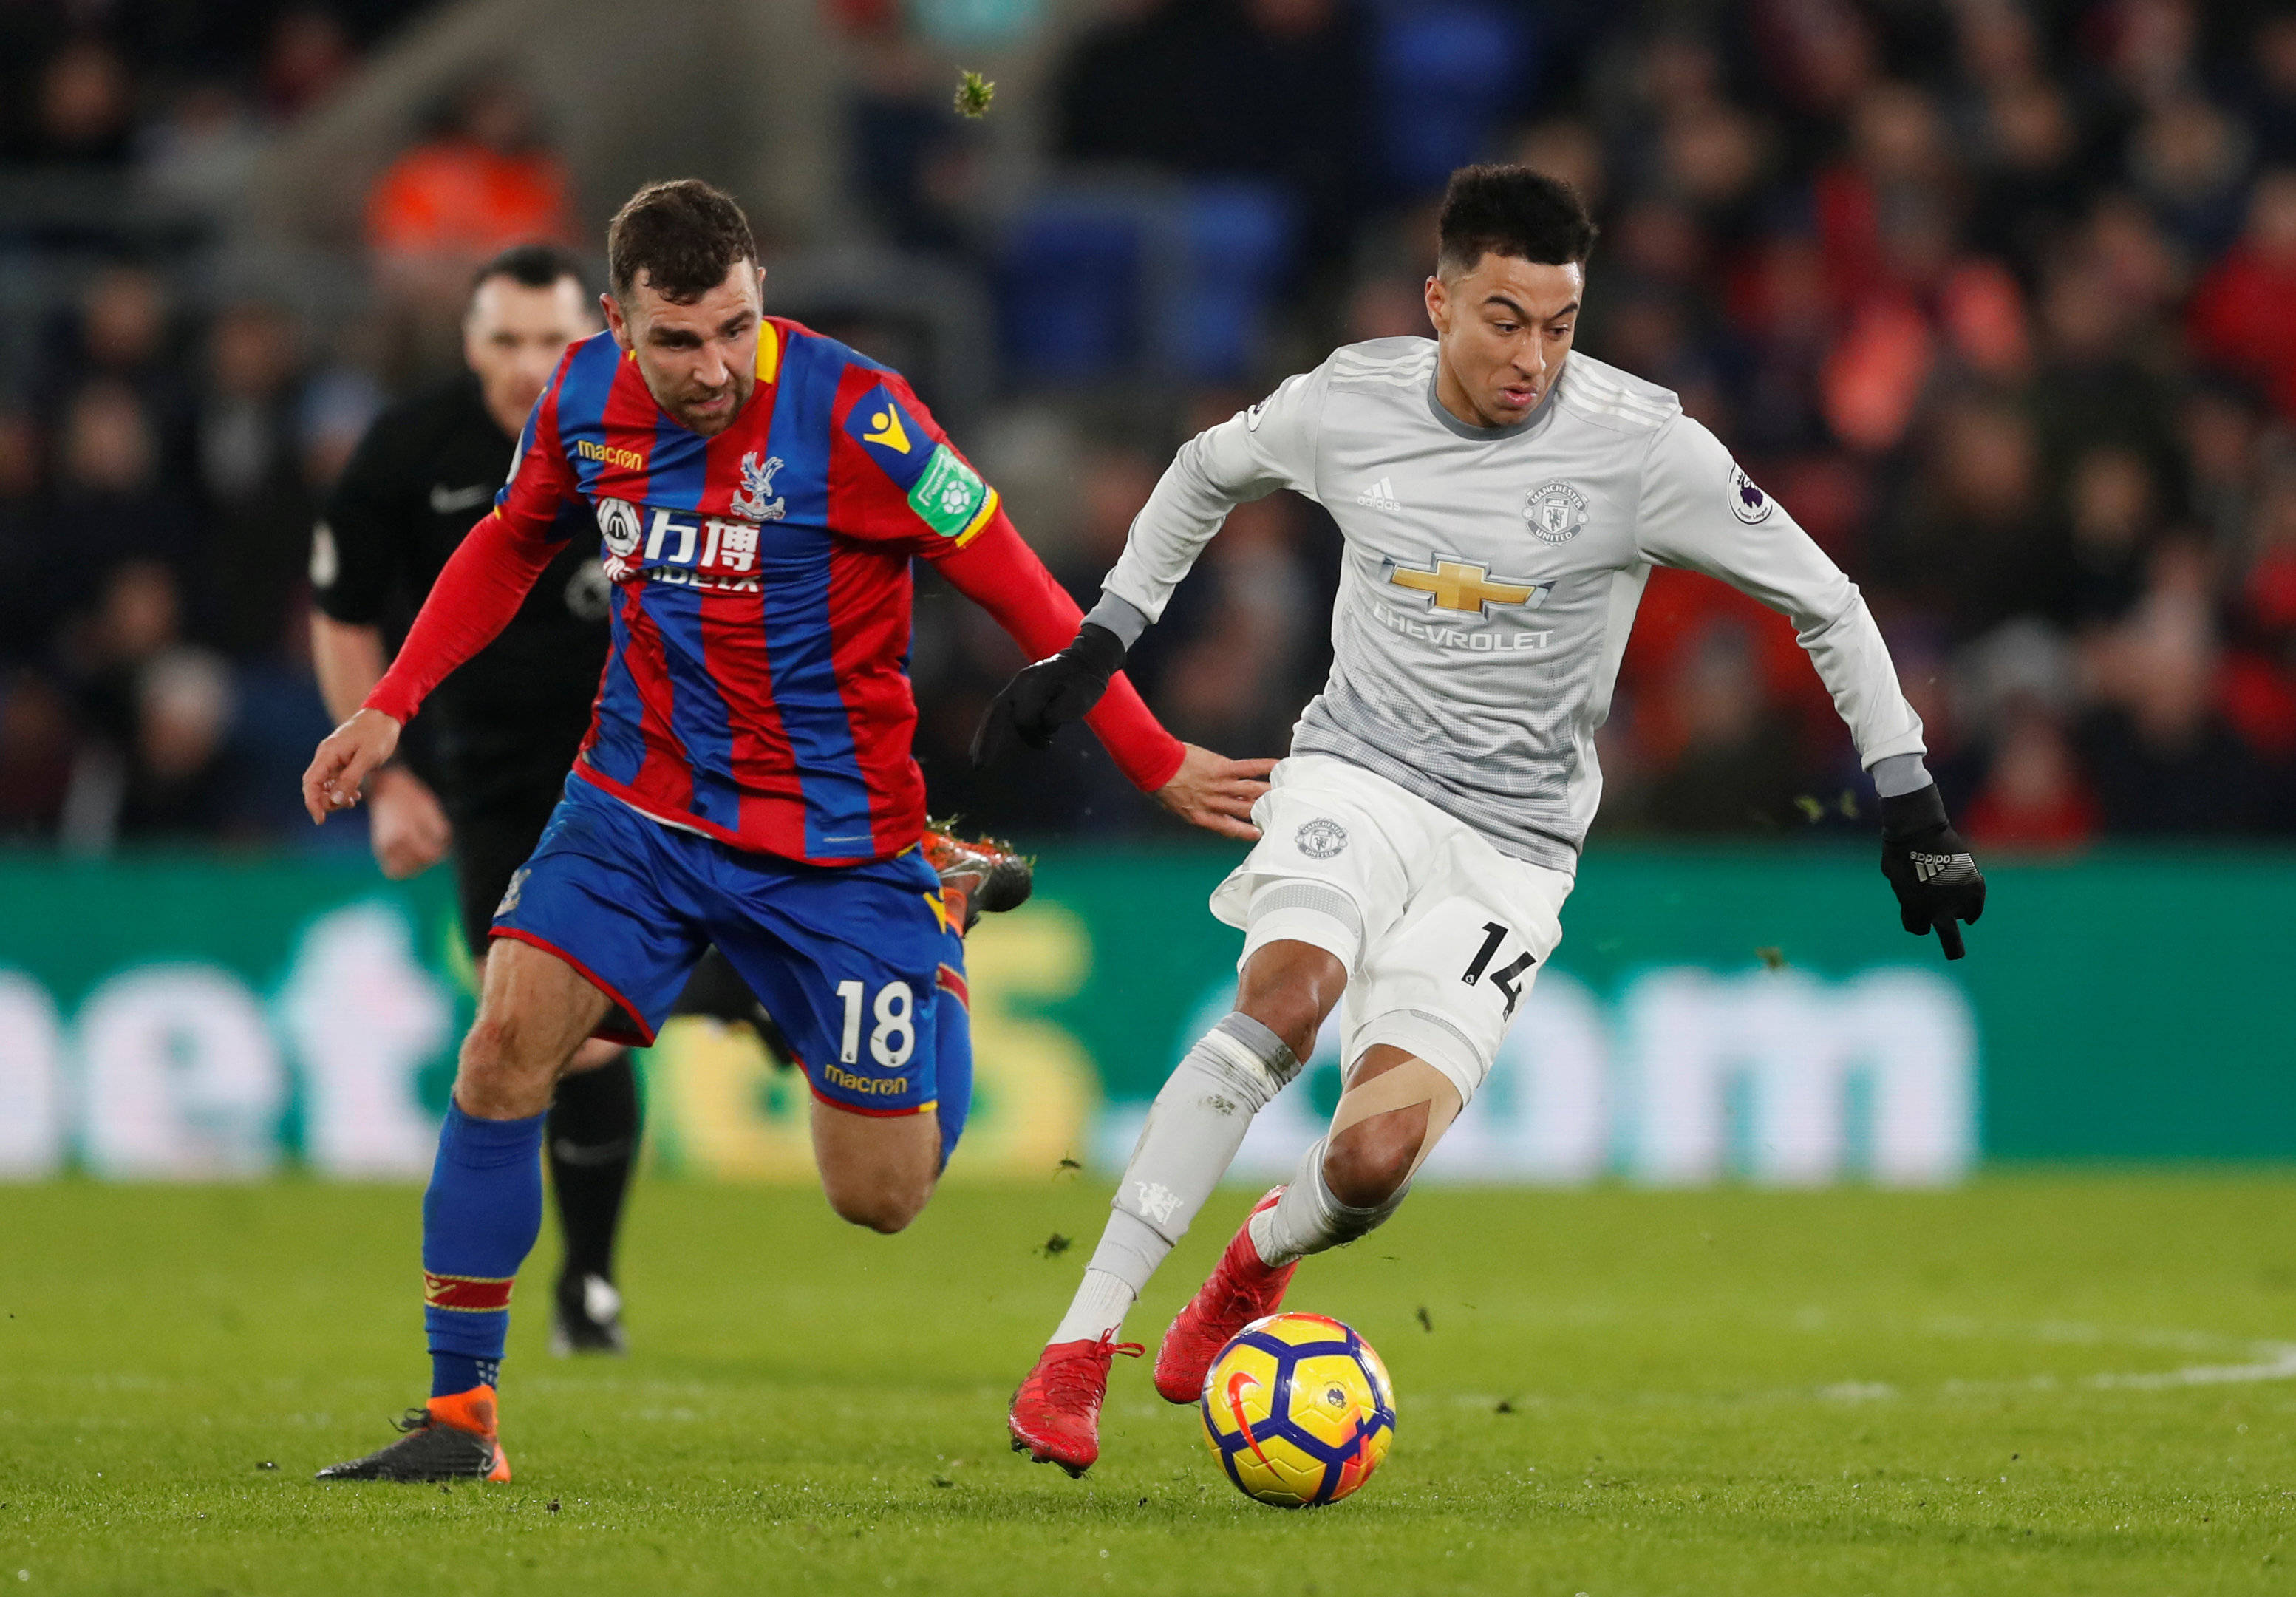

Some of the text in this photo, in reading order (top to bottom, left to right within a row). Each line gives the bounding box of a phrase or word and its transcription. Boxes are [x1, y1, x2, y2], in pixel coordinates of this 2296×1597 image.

[578, 440, 643, 471] macron
[1357, 494, 1401, 511] adidas
[1530, 484, 1583, 509] MANCHESTER
[644, 508, 761, 572] 万博
[1535, 528, 1573, 542] UNITED
[1373, 600, 1553, 651] CHEVROLET
[1305, 848, 1335, 857] UNITED
[1909, 851, 1951, 865] adidas
[1461, 921, 1537, 1023] 14
[836, 980, 916, 1069] 18
[824, 1063, 909, 1096] macron
